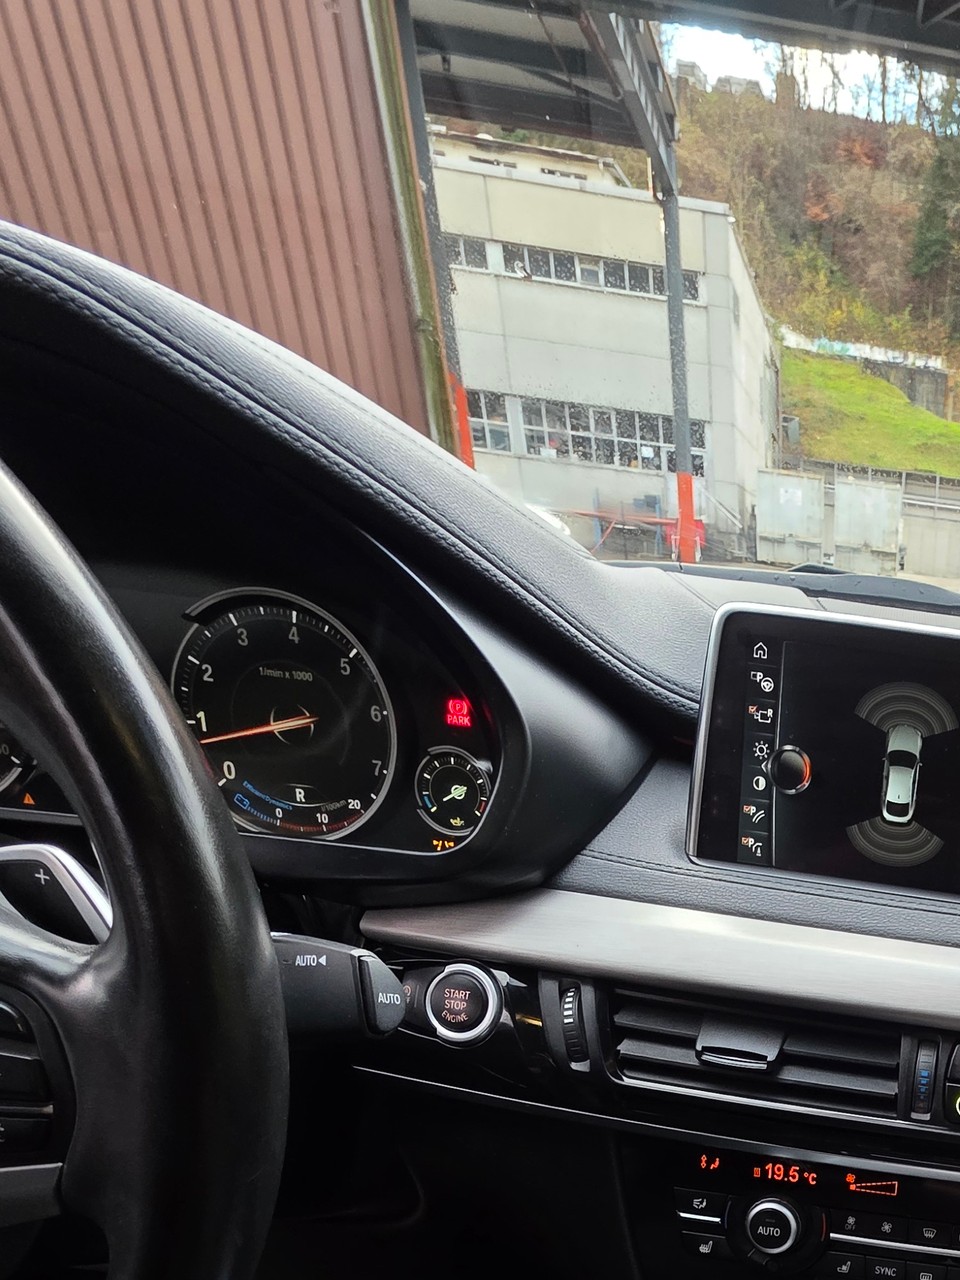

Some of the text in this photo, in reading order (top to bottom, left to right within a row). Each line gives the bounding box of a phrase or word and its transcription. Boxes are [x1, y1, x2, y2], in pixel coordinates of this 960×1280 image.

[237, 628, 249, 646] 3
[289, 627, 300, 644] 4
[201, 664, 214, 682] 2
[340, 658, 350, 675] 5
[259, 666, 284, 679] 1/min
[292, 670, 313, 682] 1000
[370, 705, 382, 722] 6
[196, 711, 207, 732] 1
[447, 715, 471, 726] PARK
[223, 761, 236, 779] 0
[371, 760, 382, 776] 7
[295, 788, 306, 802] R
[347, 799, 361, 810] 20
[275, 808, 283, 818] 0
[316, 812, 329, 823] 10
[295, 955, 317, 966] AUTO
[377, 992, 401, 1005] AUTO
[444, 988, 471, 1000] START
[444, 1000, 467, 1011] STOP
[441, 1010, 469, 1023] ENGINE
[765, 1162, 800, 1182] 19.5
[757, 1226, 781, 1237] AUTO
[874, 1265, 897, 1277] SYNC
